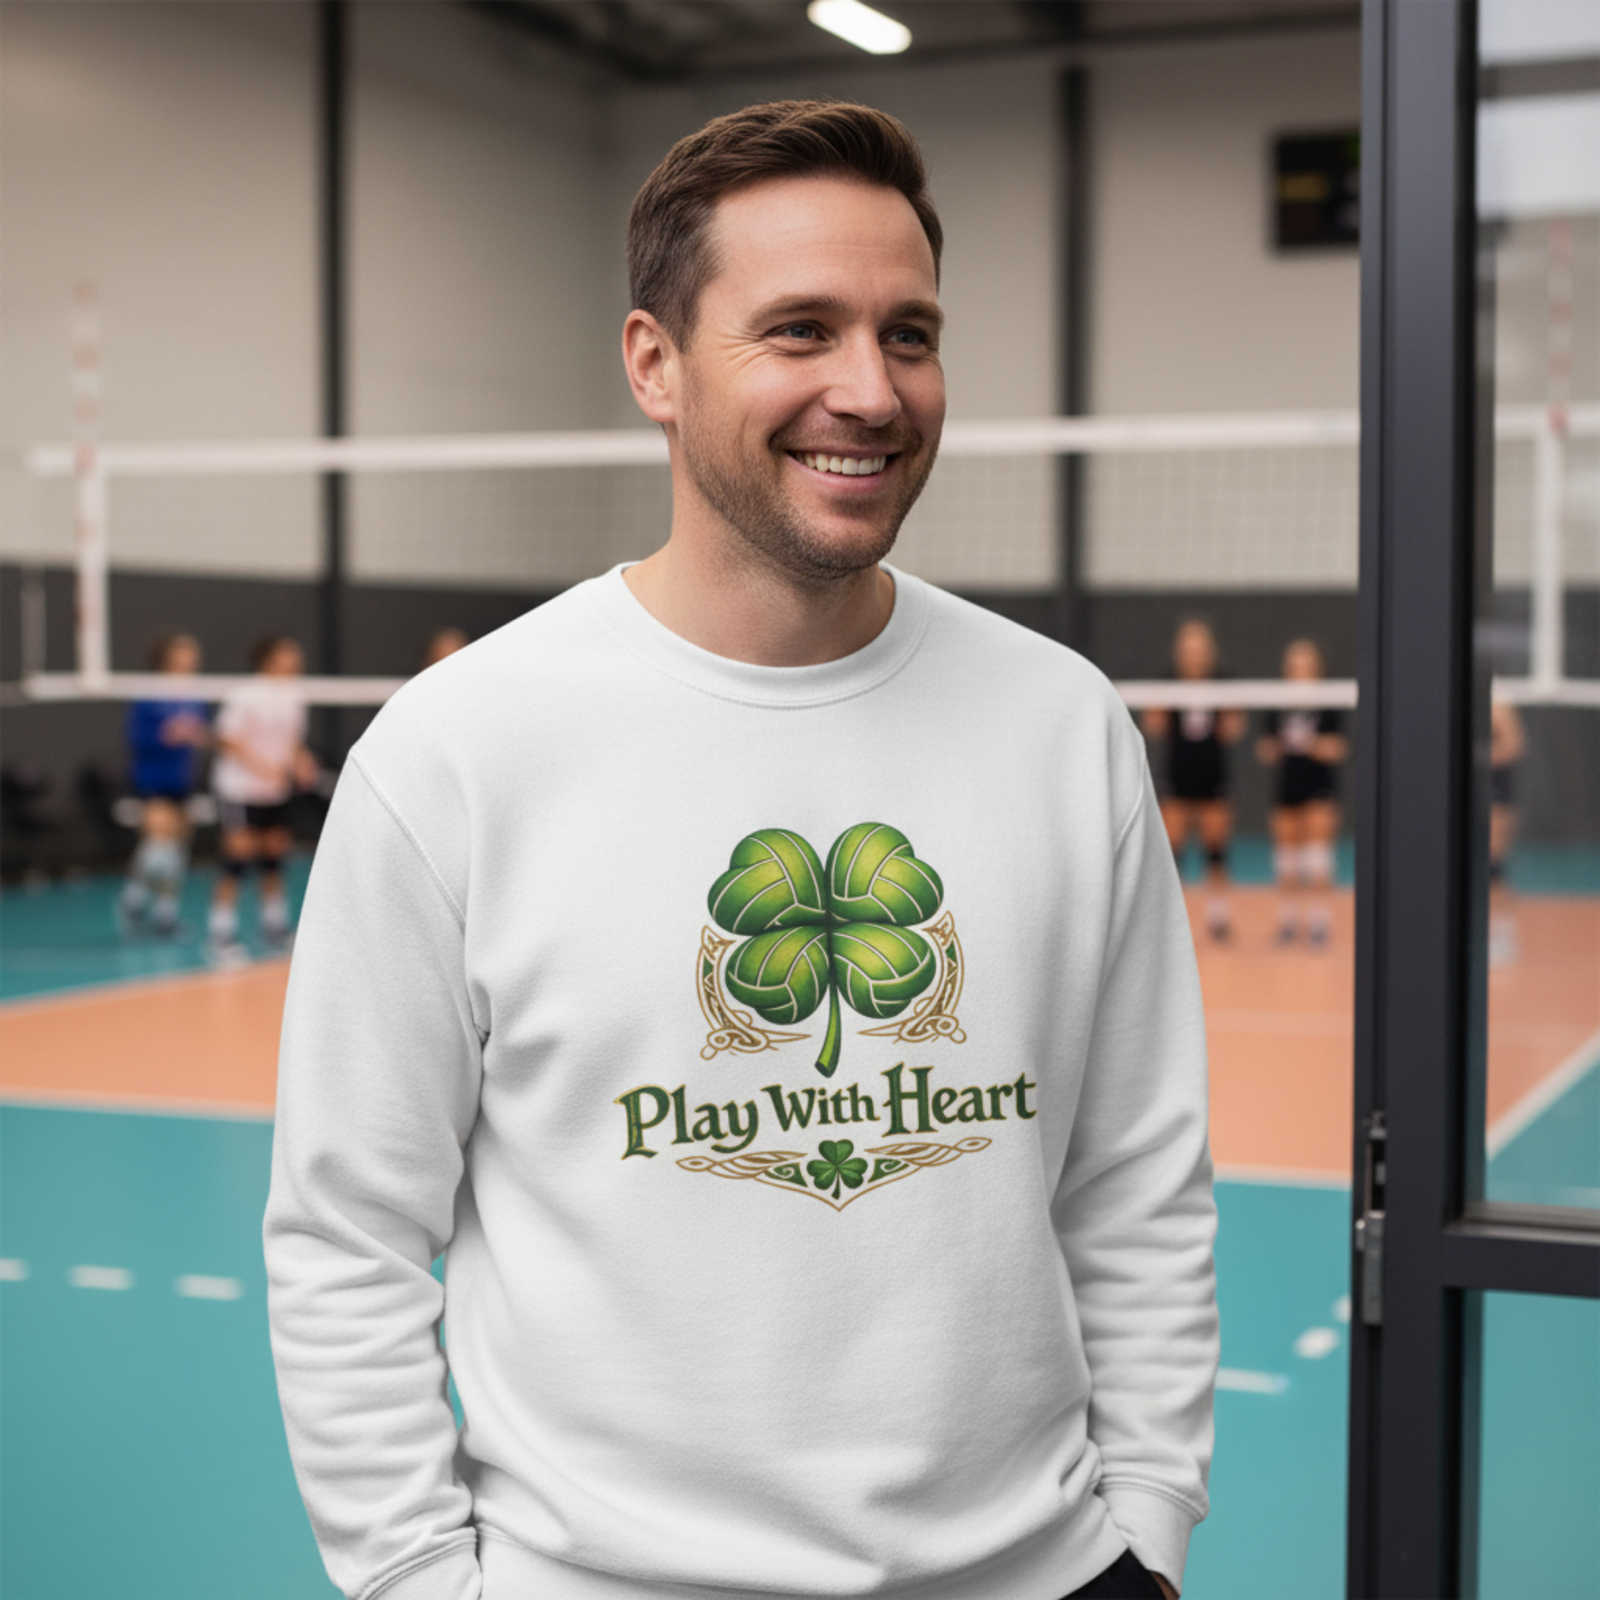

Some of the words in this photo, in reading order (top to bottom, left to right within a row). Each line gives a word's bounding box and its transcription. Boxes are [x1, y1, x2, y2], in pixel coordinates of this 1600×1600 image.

[613, 1083, 759, 1160] Play
[761, 1083, 881, 1132] With
[880, 1061, 1037, 1138] Heart
